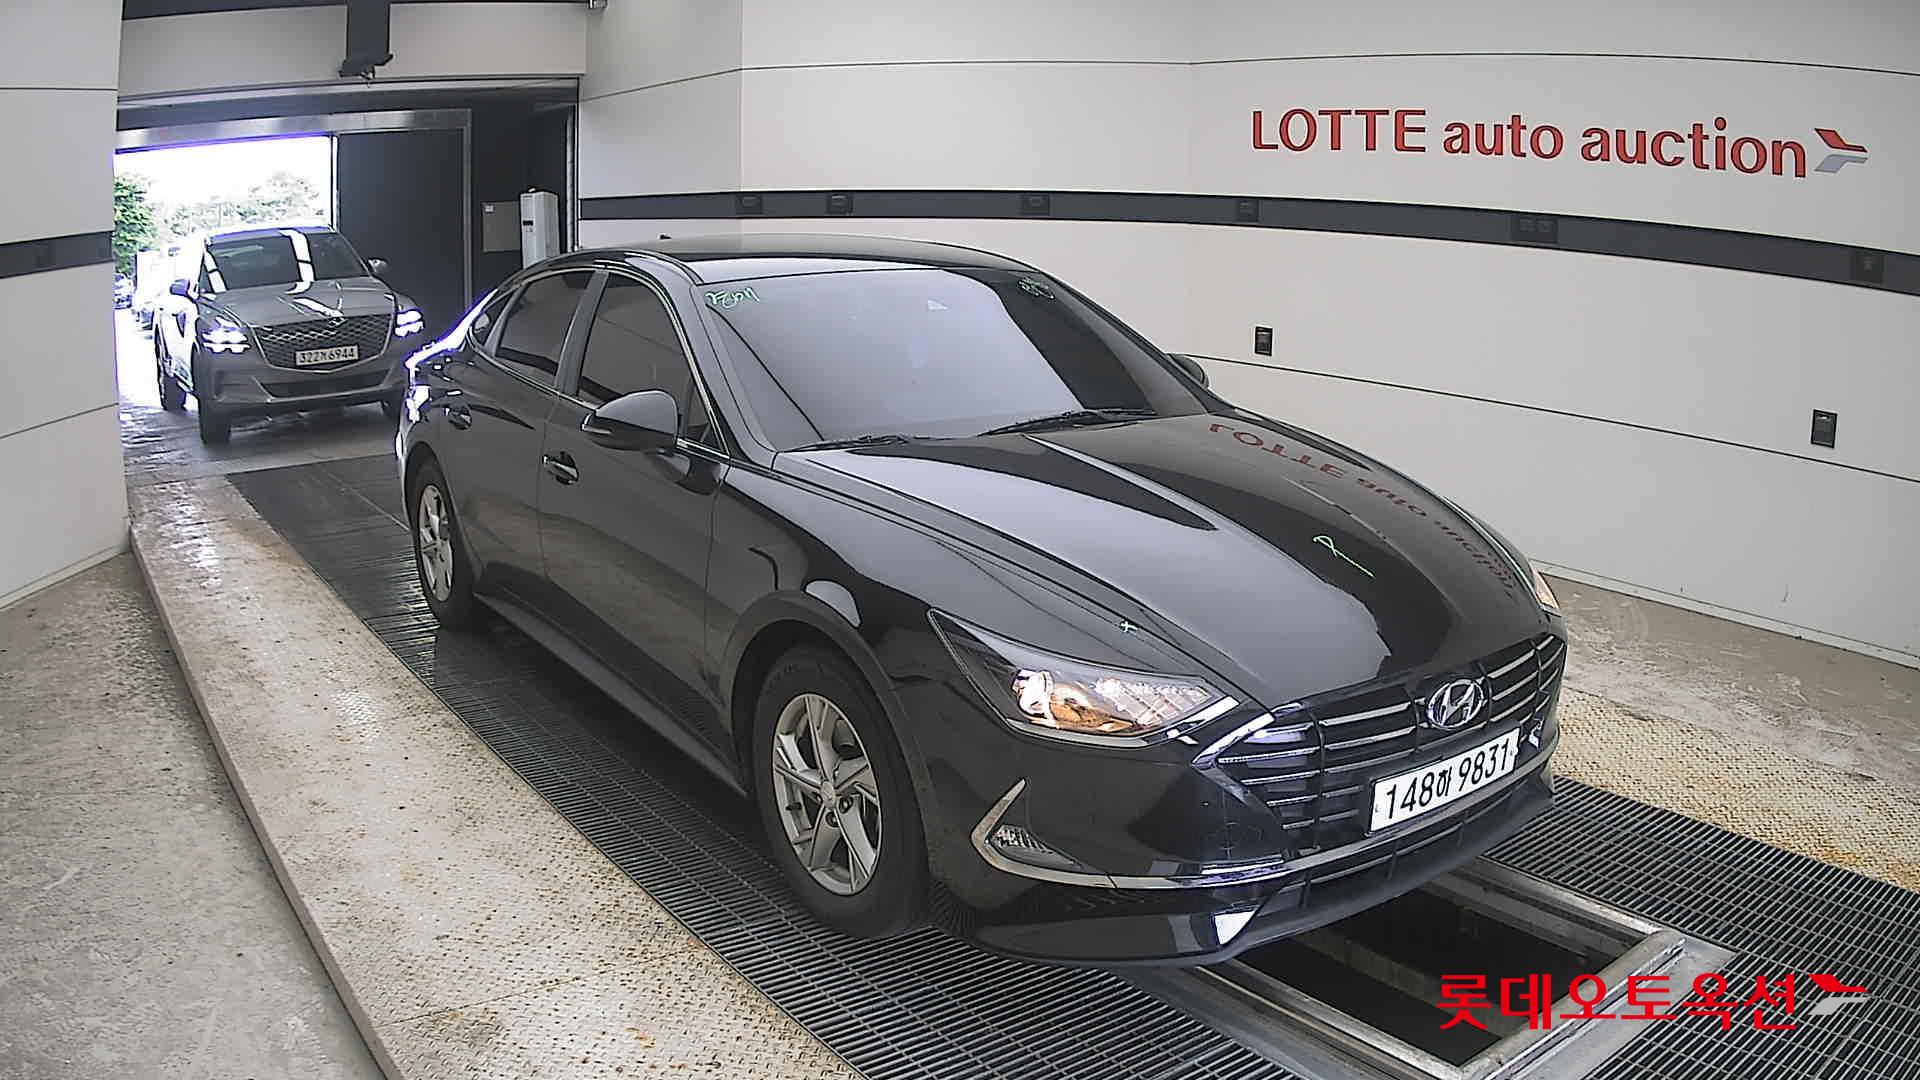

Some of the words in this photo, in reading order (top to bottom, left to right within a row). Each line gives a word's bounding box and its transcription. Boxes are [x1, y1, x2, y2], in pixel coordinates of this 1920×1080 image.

[1252, 108, 1427, 153] LOTTE
[1443, 115, 1564, 160] auto
[1581, 116, 1806, 178] auction
[1458, 738, 1510, 792] 9831
